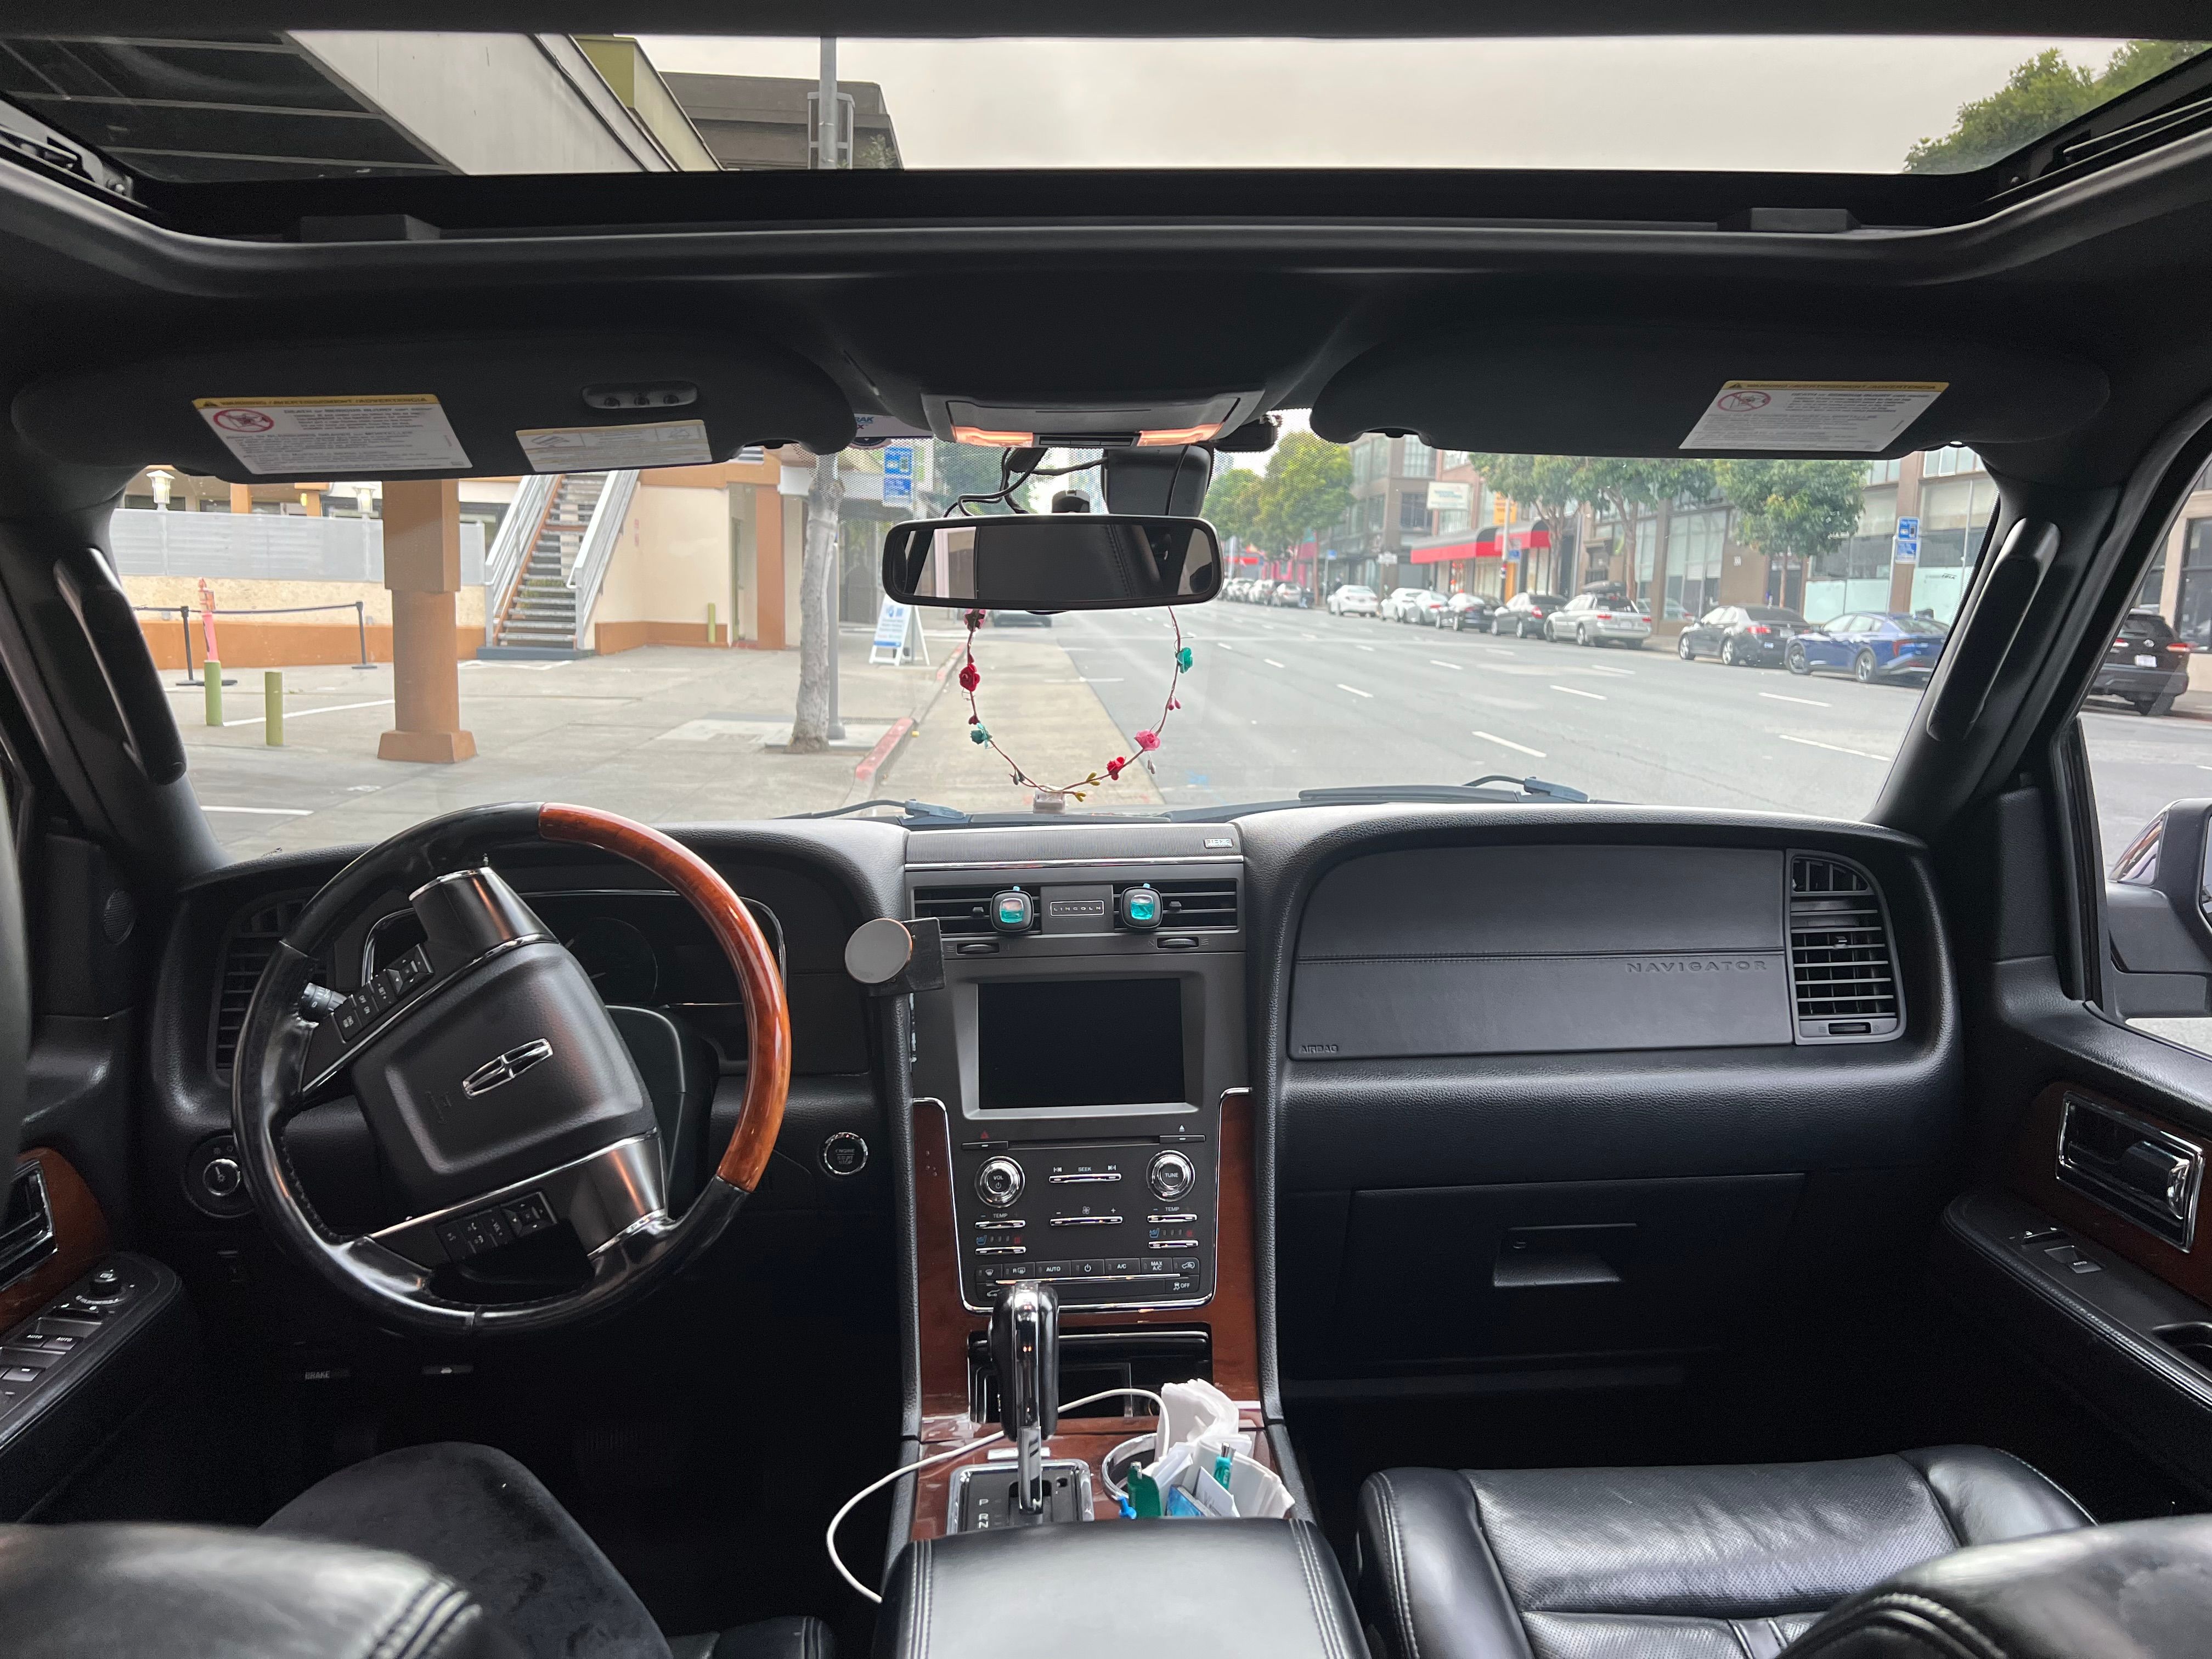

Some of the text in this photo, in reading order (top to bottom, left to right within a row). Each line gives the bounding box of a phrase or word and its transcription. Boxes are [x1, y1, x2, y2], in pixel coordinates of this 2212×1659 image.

[1627, 961, 1767, 973] NAVIGATOR
[1299, 1045, 1339, 1054] AIRBAG
[978, 1521, 989, 1529] N
